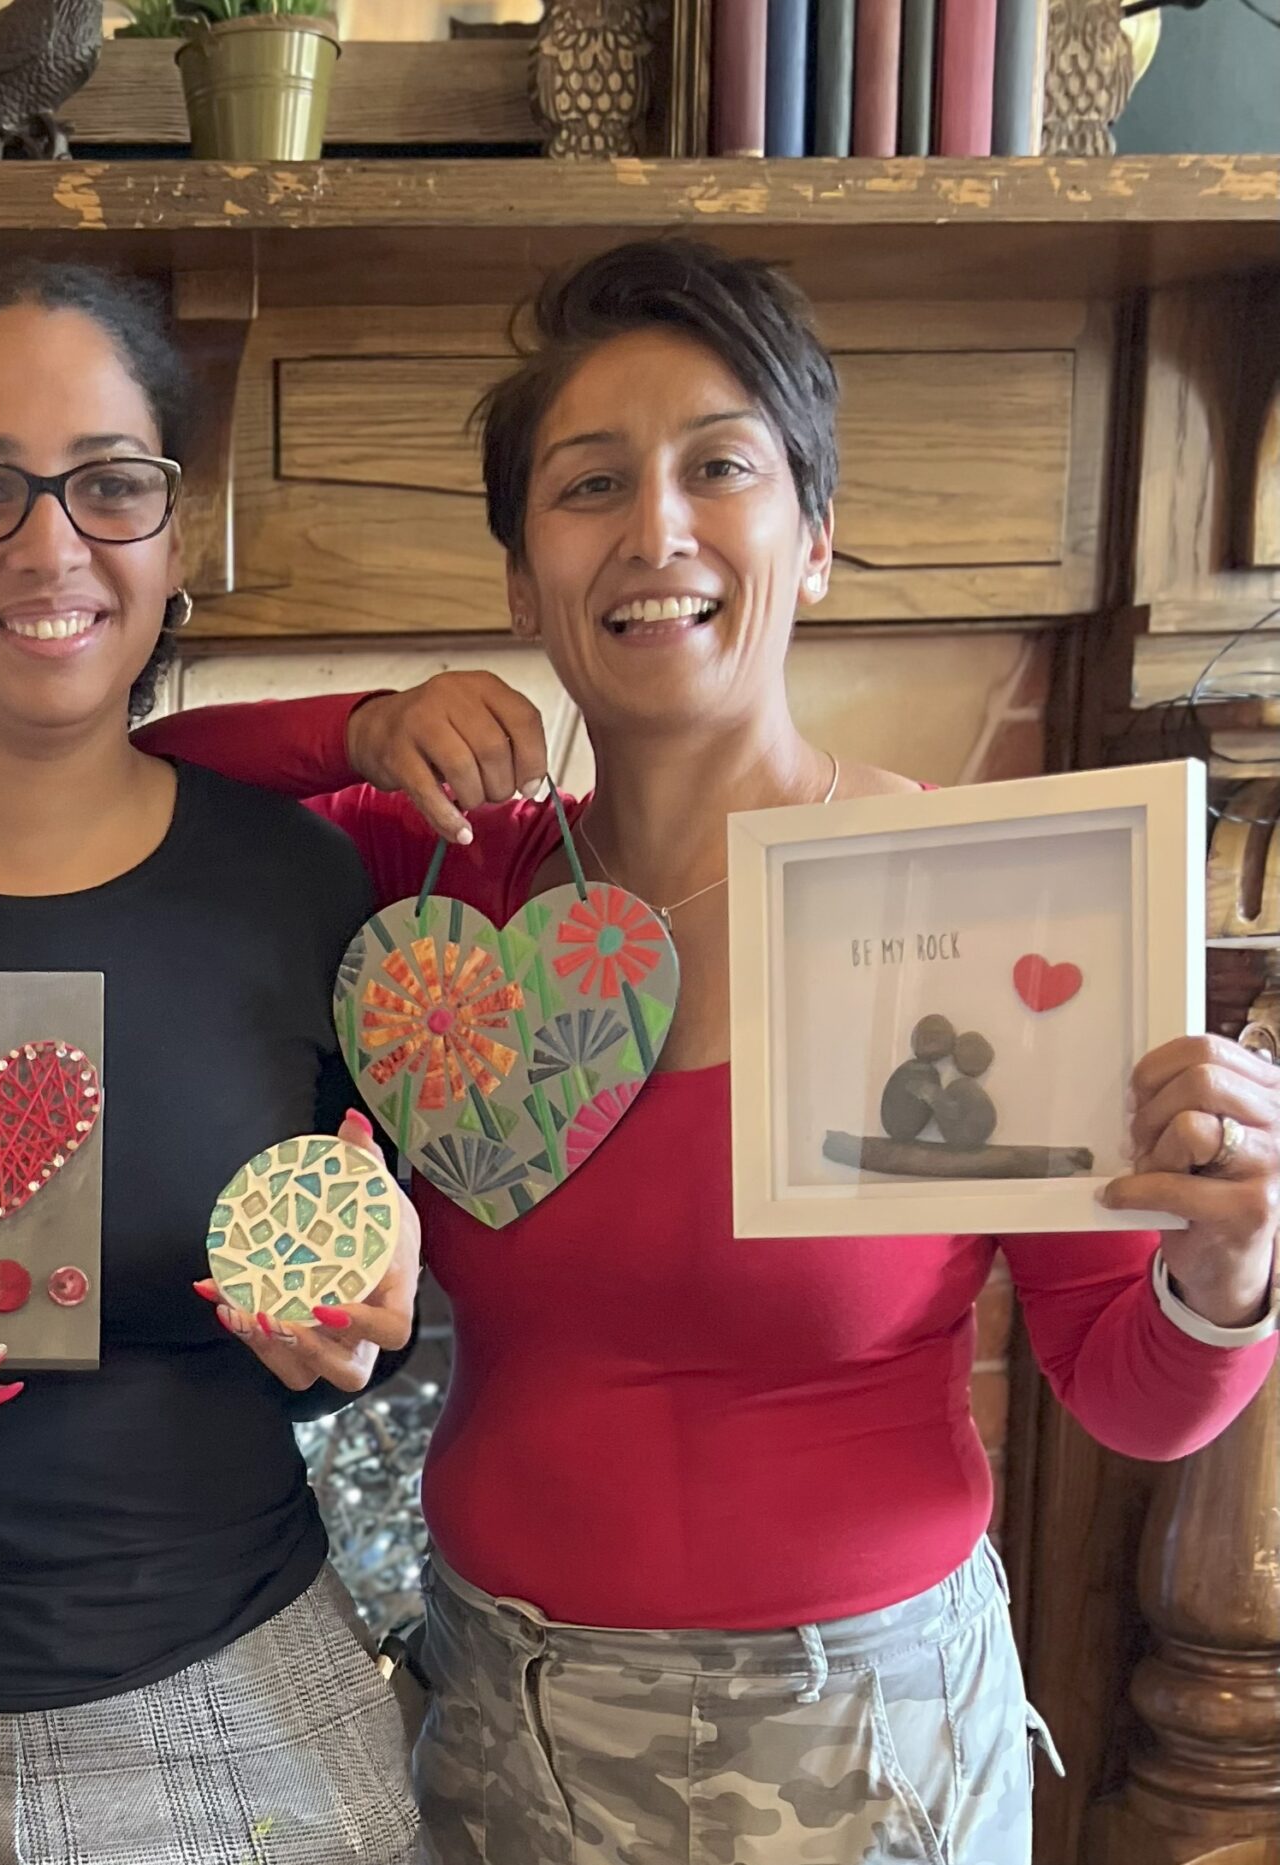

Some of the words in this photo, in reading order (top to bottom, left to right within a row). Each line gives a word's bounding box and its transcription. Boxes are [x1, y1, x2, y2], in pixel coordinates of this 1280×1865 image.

[851, 938, 873, 967] BE
[881, 937, 905, 965] MY
[916, 930, 961, 962] ROCK
